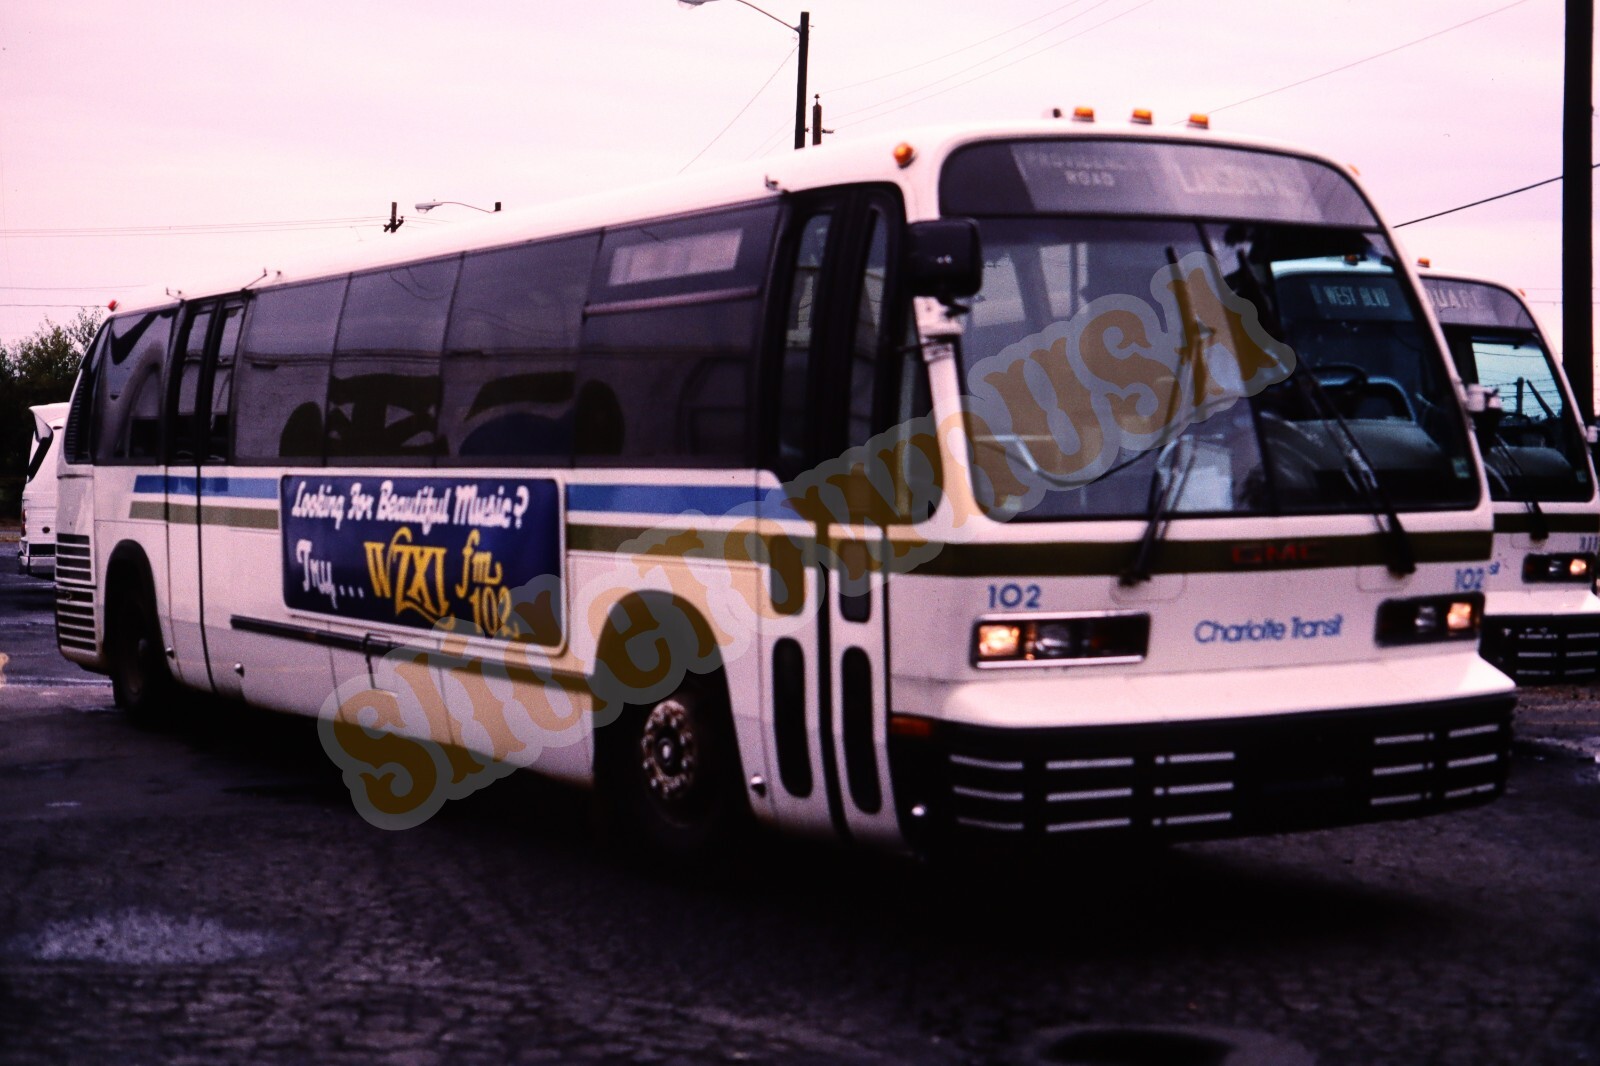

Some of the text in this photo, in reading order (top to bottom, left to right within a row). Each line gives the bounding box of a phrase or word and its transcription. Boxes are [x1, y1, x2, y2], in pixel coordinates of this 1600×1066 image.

[1322, 286, 1357, 306] WEST
[291, 479, 530, 536] Looking For Beautiful Music?
[1232, 543, 1325, 565] GMC
[1454, 568, 1485, 590] 102
[987, 583, 1042, 609] 102
[469, 586, 520, 639] 102
